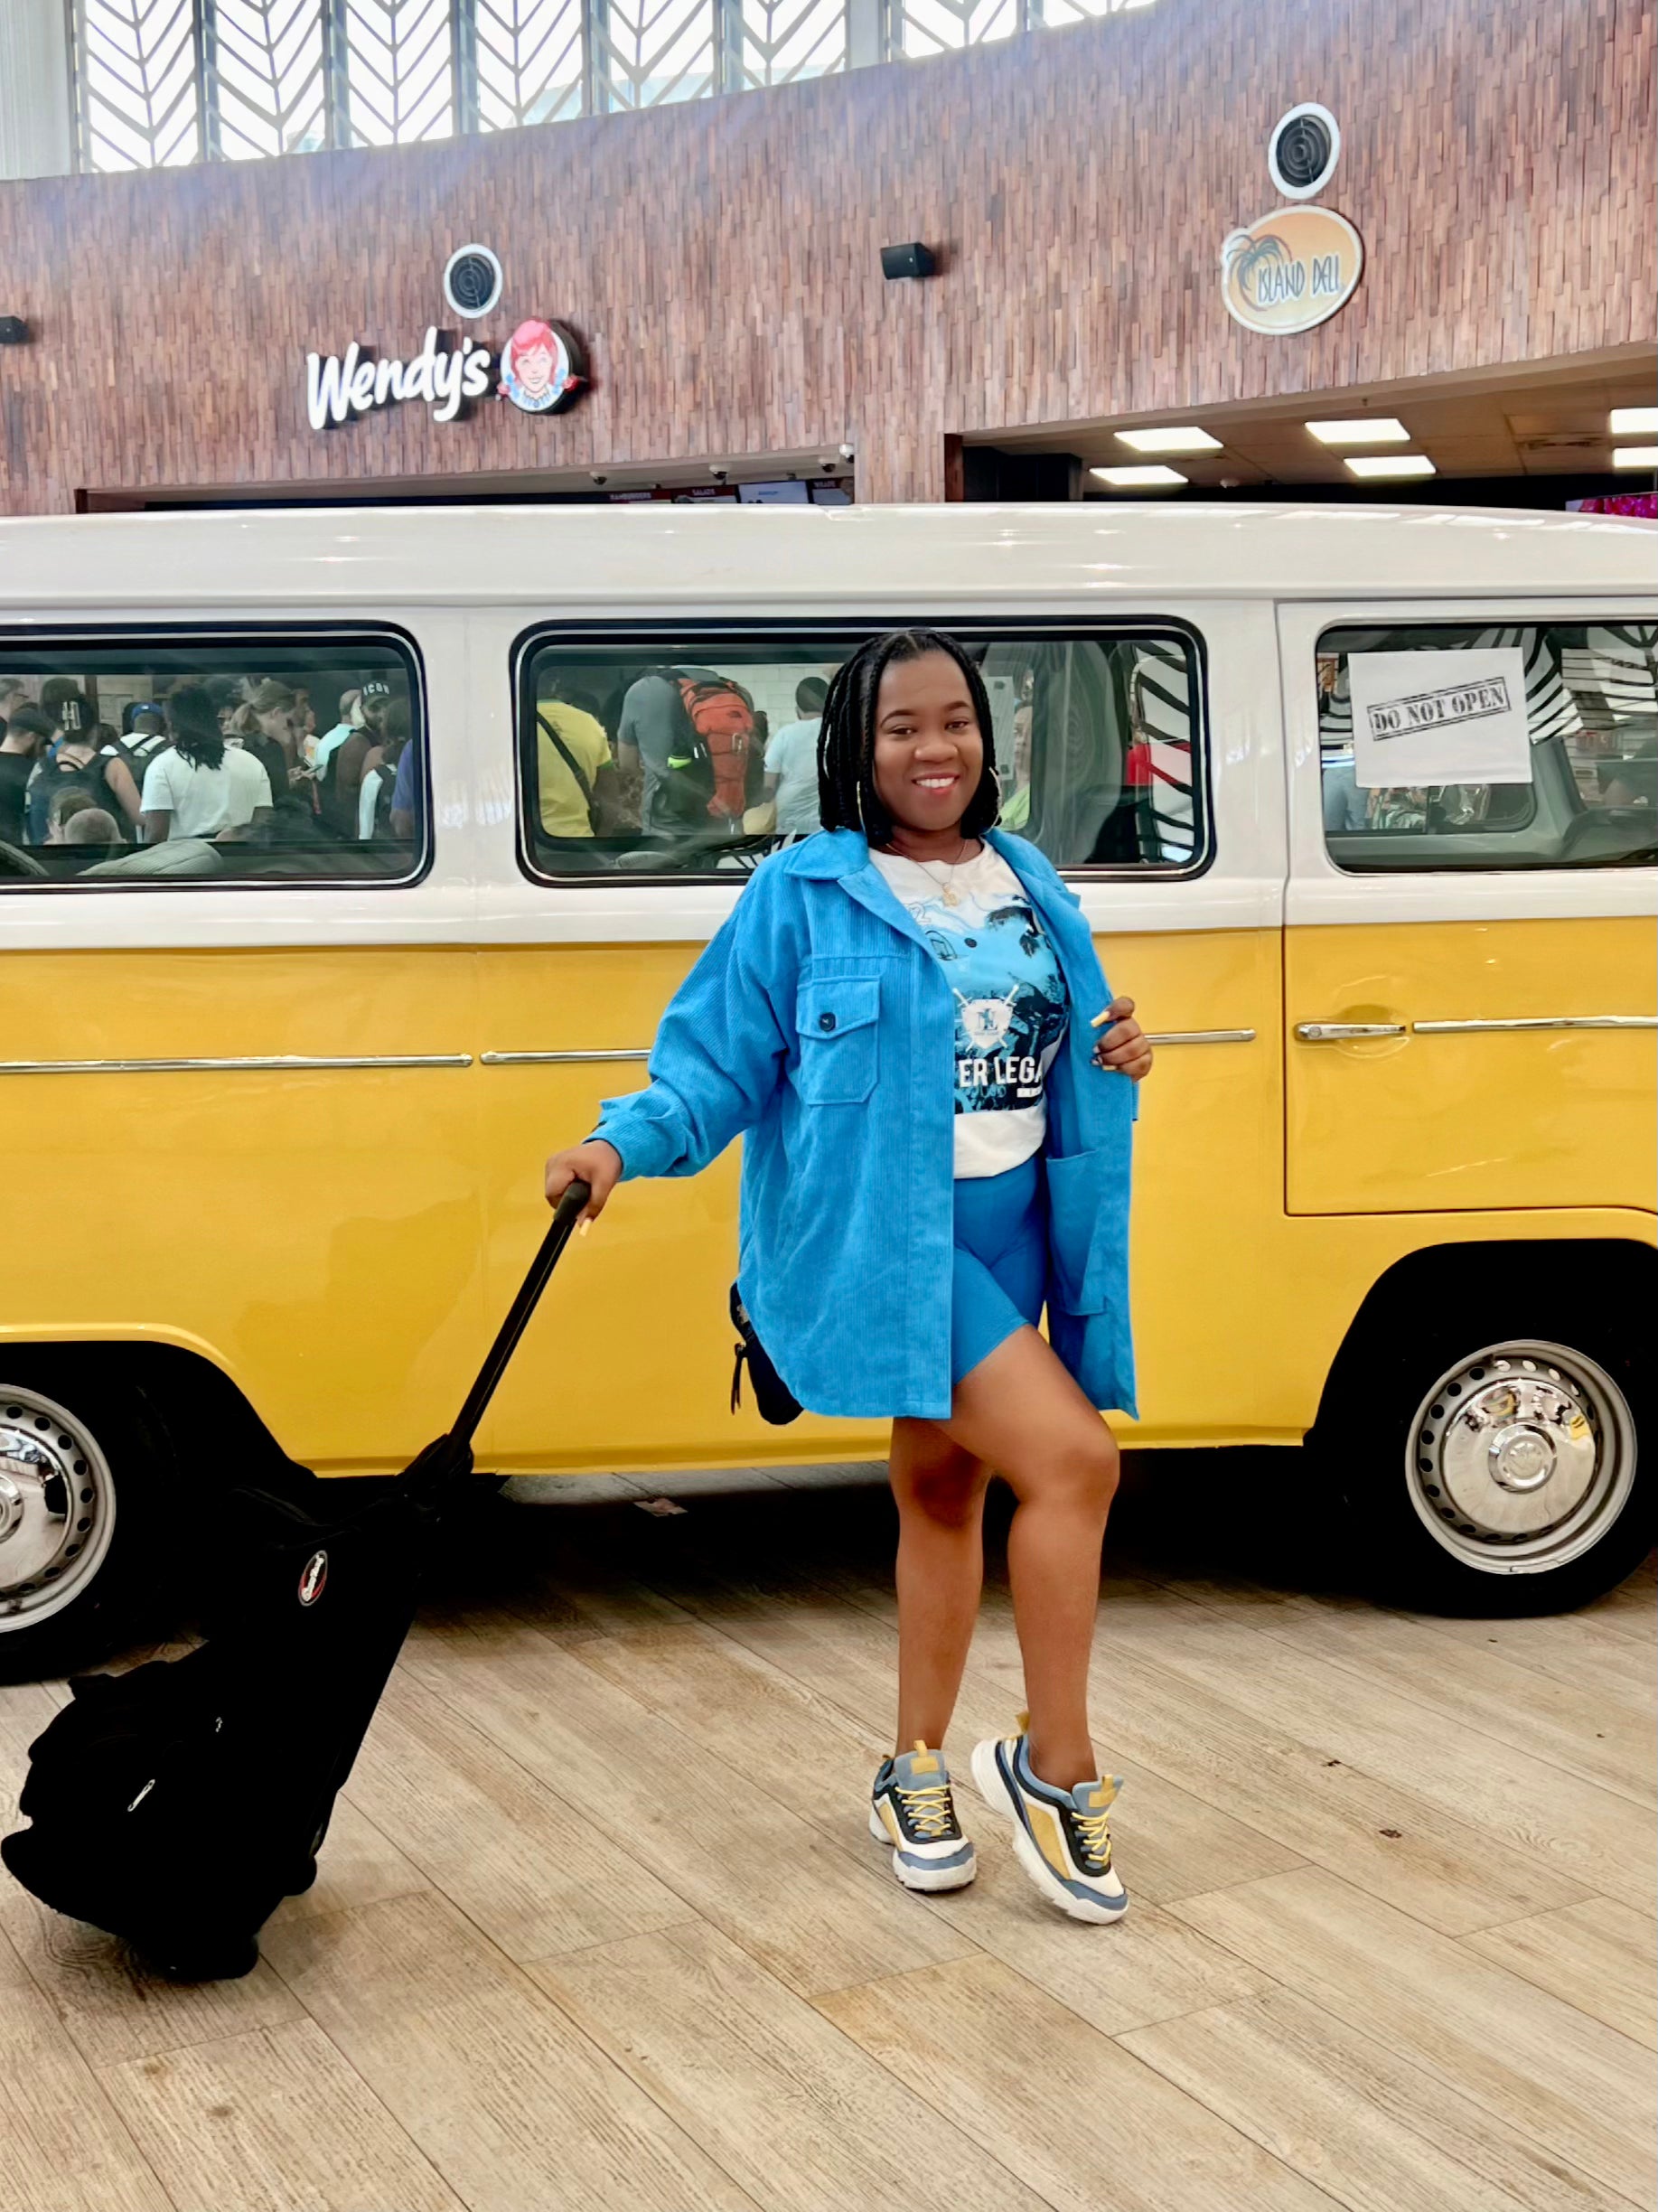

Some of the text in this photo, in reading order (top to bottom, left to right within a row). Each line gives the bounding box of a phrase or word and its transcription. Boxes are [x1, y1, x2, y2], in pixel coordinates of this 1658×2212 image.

[1258, 254, 1340, 304] ISLAND DELI
[307, 325, 491, 430] Wendy's
[1372, 686, 1505, 733] DO NOT OPEN
